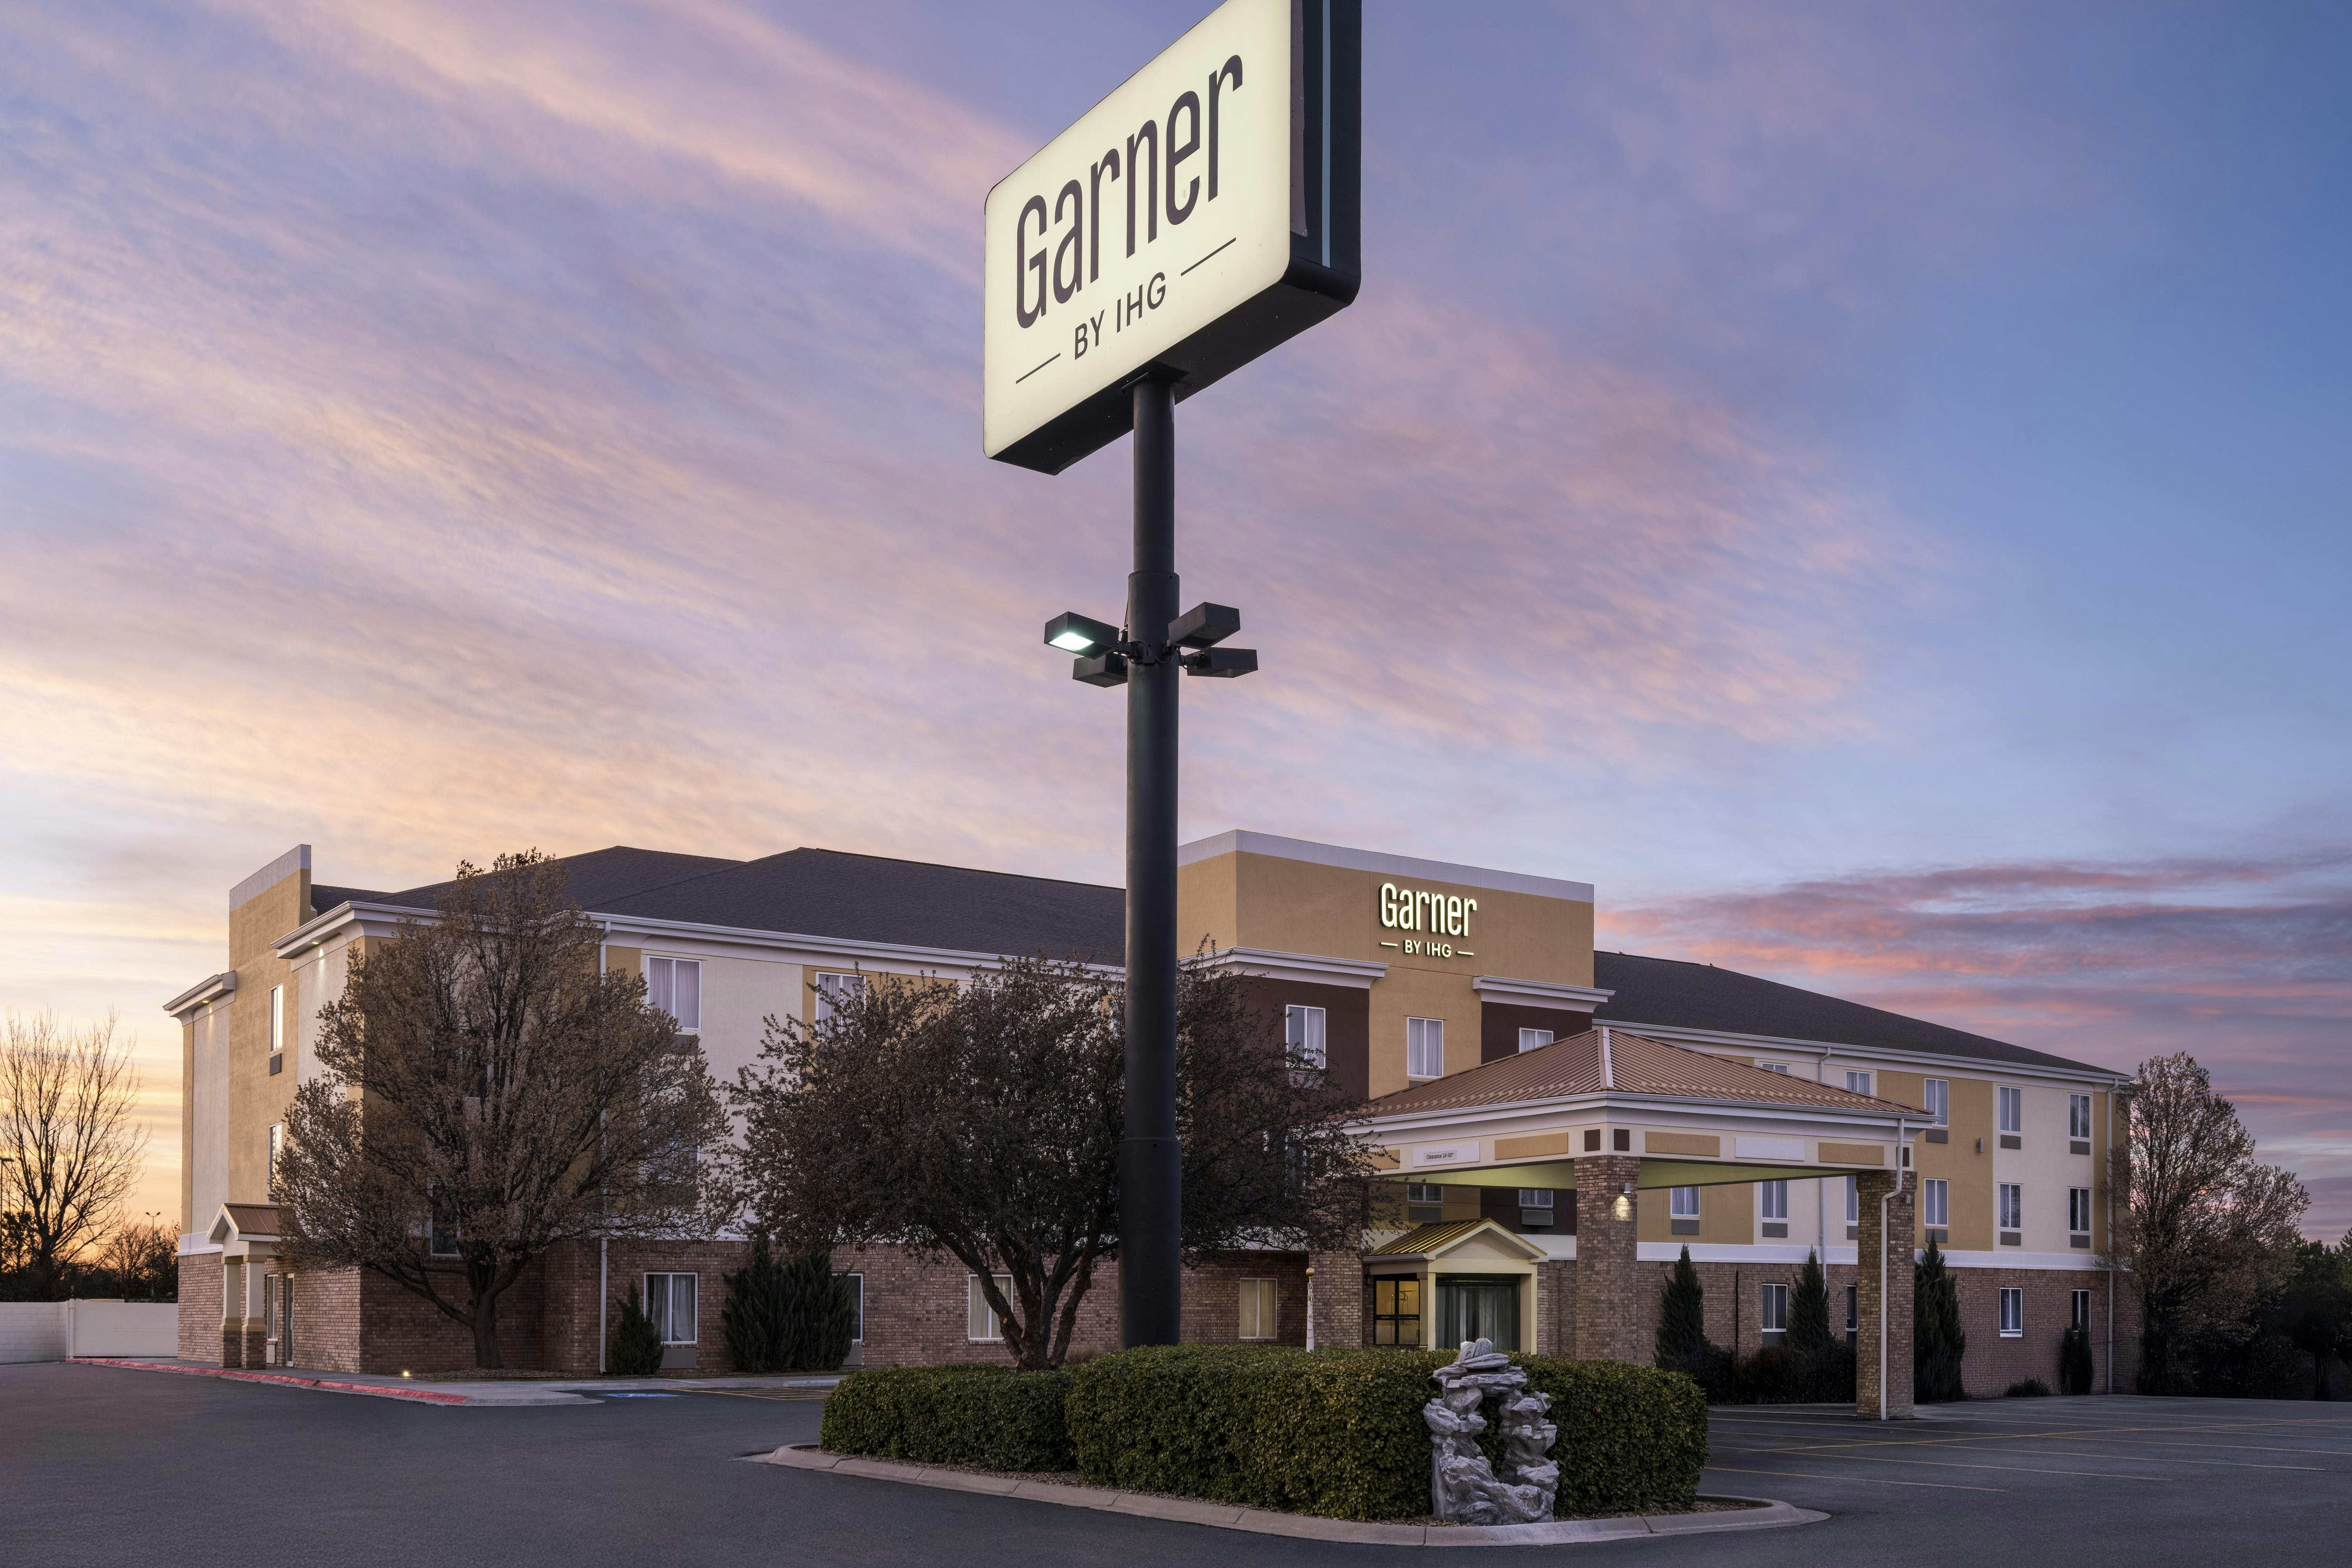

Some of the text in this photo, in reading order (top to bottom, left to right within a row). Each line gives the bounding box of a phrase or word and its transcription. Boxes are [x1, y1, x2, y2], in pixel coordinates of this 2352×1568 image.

[1016, 54, 1243, 329] Garner
[1074, 272, 1166, 361] BY IHG
[1380, 882, 1477, 936] Garner
[1404, 939, 1452, 958] BY IHG
